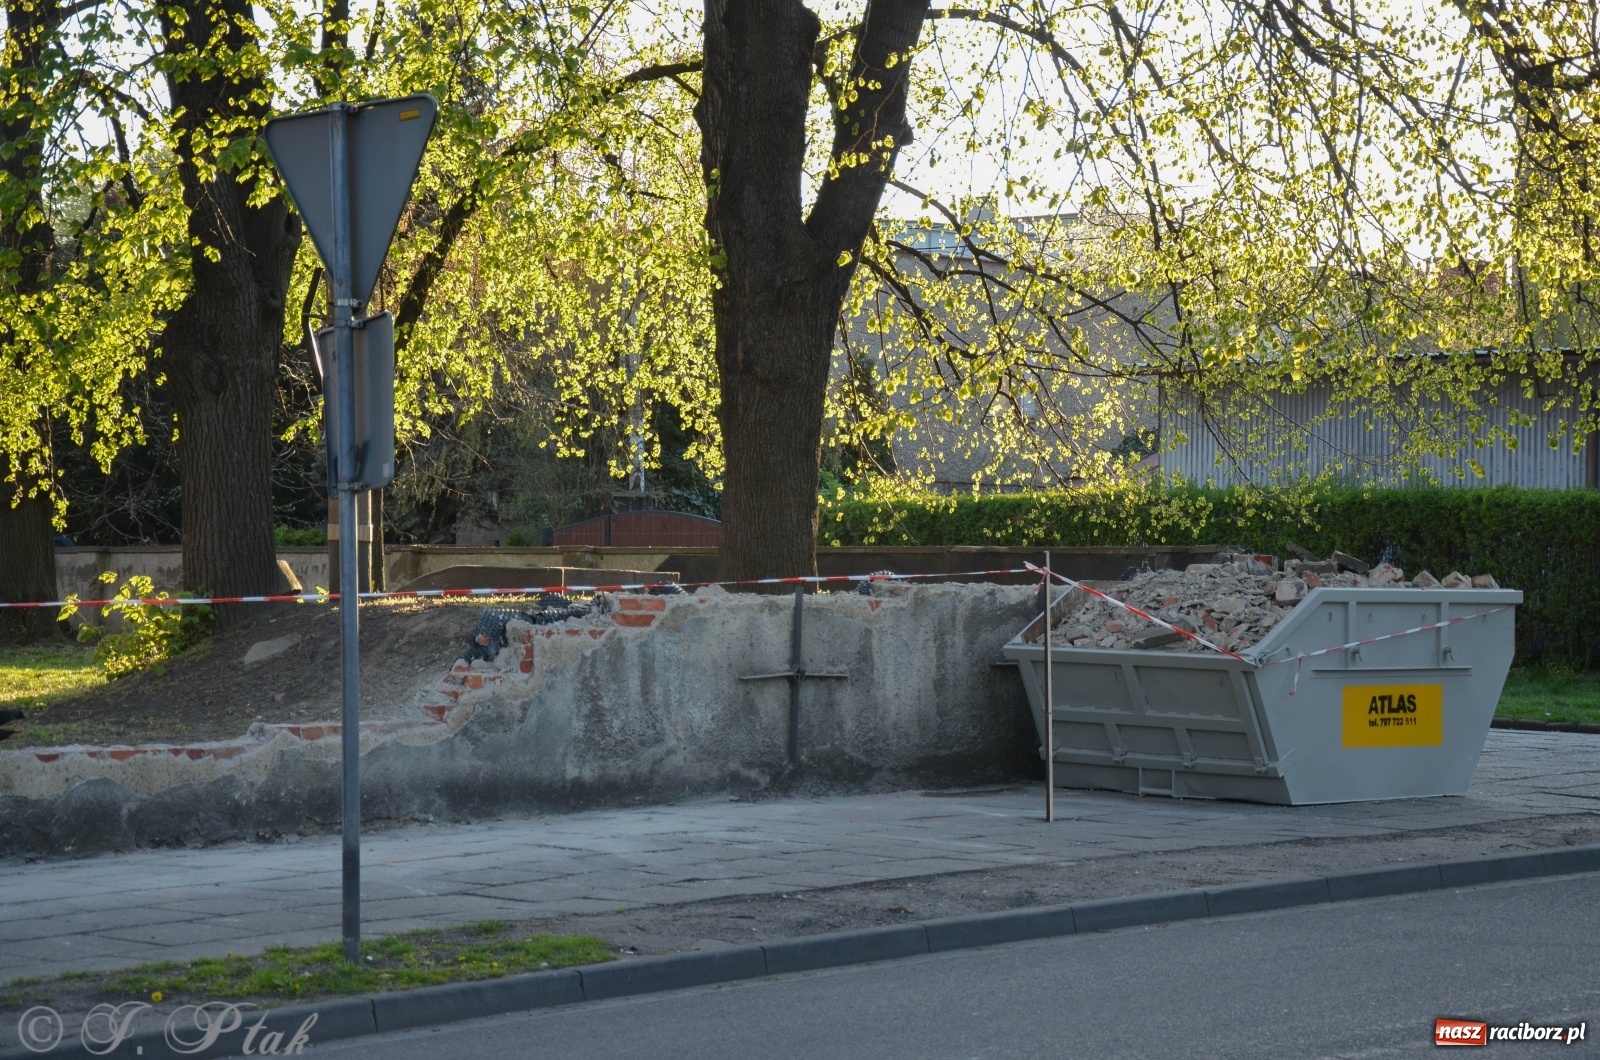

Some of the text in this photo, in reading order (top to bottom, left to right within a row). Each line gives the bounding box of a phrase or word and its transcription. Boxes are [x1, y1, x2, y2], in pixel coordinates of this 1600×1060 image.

[1368, 694, 1417, 714] ATLAS
[1368, 718, 1379, 727] tel.
[1405, 717, 1417, 725] 511
